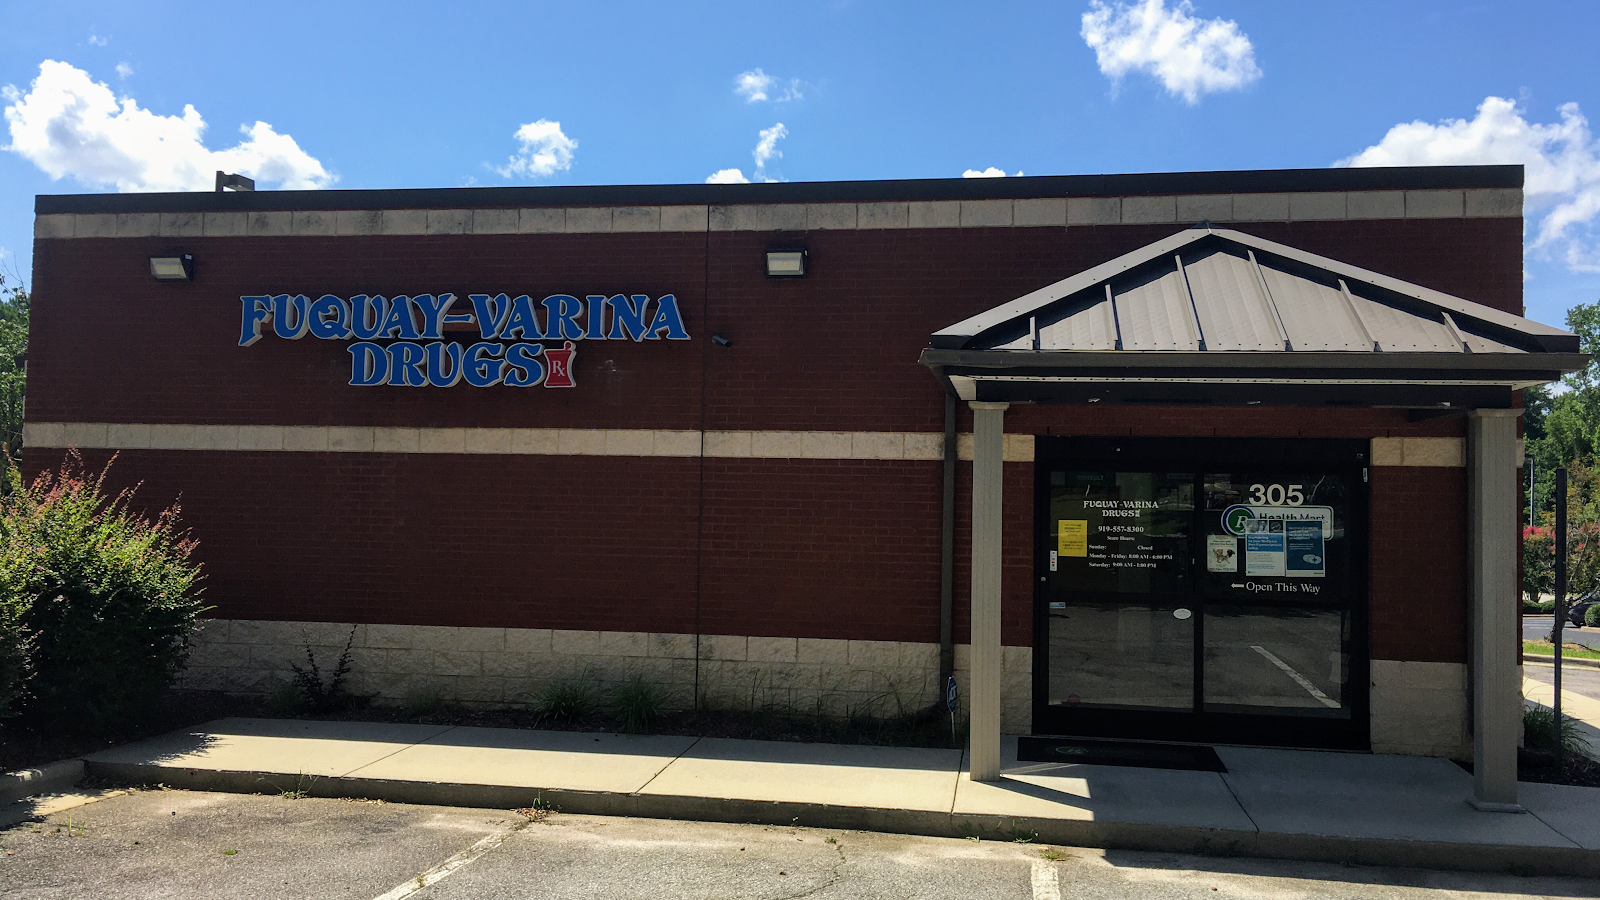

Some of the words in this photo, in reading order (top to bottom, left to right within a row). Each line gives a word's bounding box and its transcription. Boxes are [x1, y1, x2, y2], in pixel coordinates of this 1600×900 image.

[238, 293, 691, 346] FUQUAY-VARINA
[348, 342, 545, 388] DRUGS
[1248, 483, 1305, 506] 305
[1083, 500, 1159, 509] FUQUAY-VARINA
[1102, 509, 1135, 517] DRUGS
[1098, 525, 1144, 533] 919-557-8300
[1245, 581, 1273, 593] Open
[1274, 582, 1298, 592] This
[1300, 583, 1321, 595] Way
